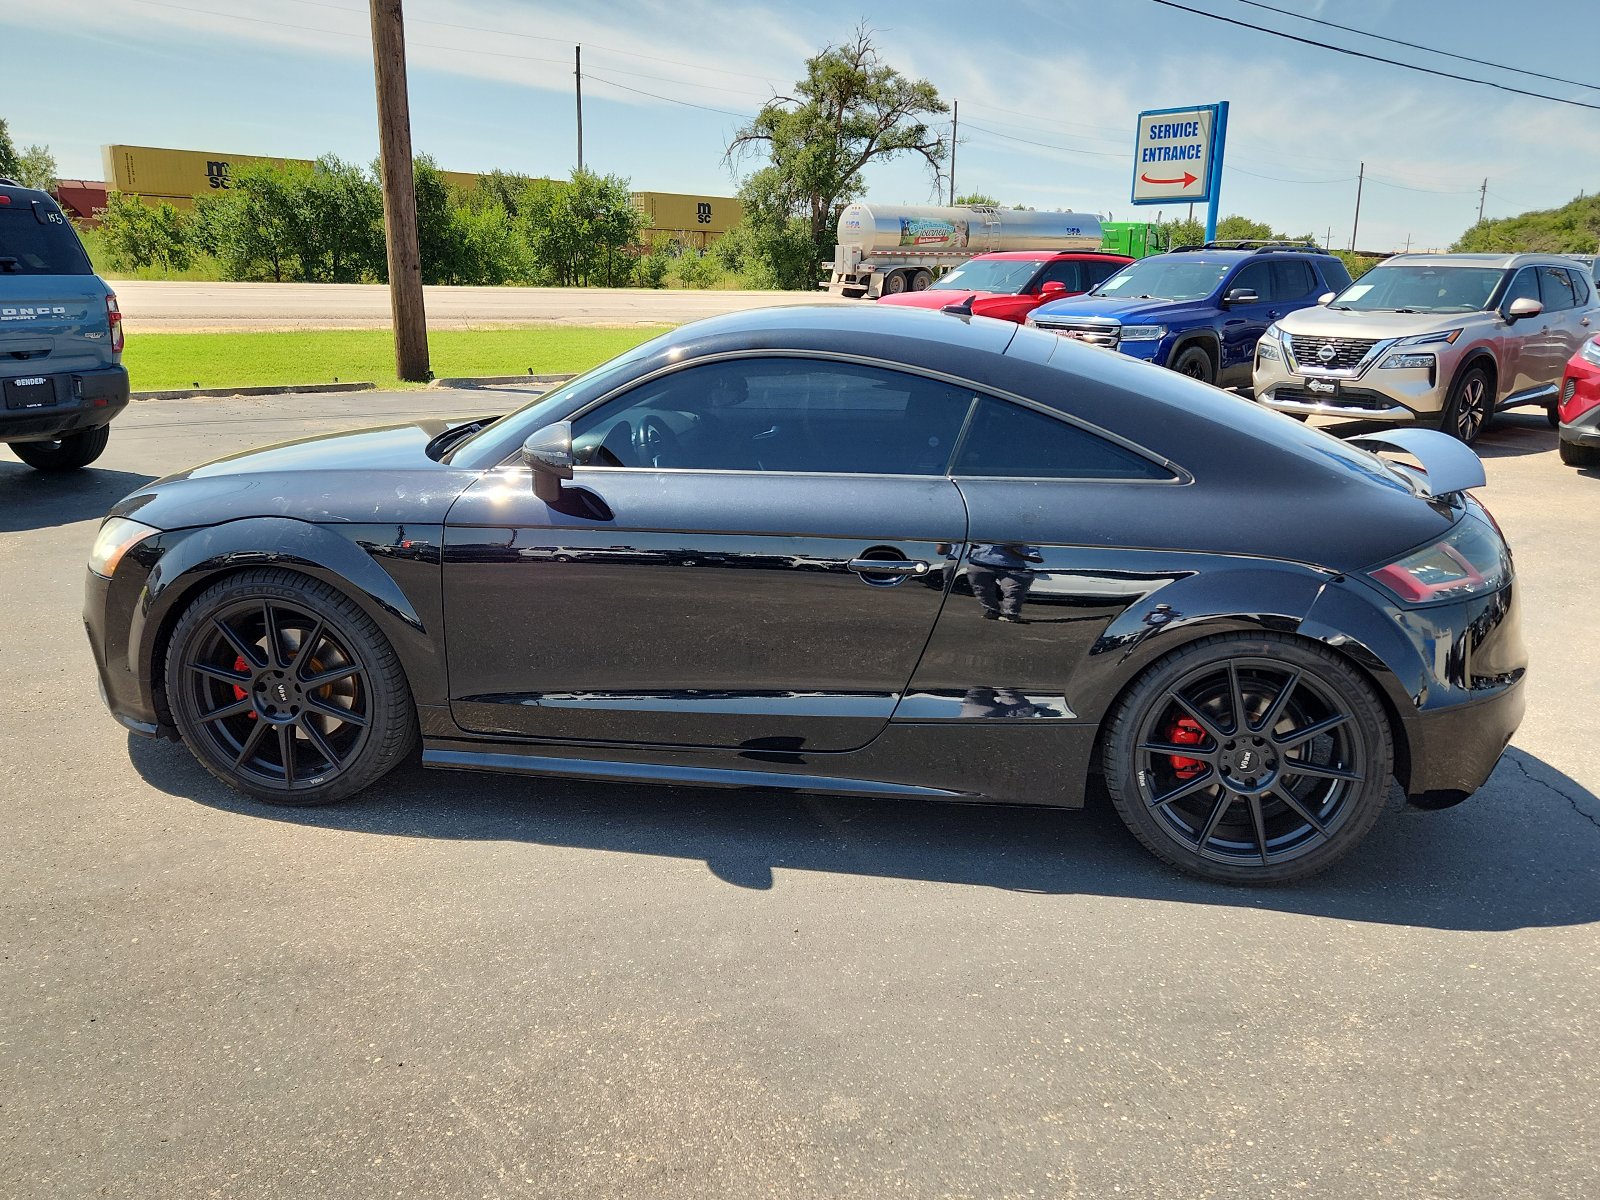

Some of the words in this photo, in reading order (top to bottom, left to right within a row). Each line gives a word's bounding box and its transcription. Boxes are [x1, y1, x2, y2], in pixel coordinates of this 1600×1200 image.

[1149, 121, 1199, 140] SERVICE
[1142, 144, 1202, 163] ENTRANCE
[15, 377, 44, 386] BENDER
[231, 586, 296, 597] CELIMO
